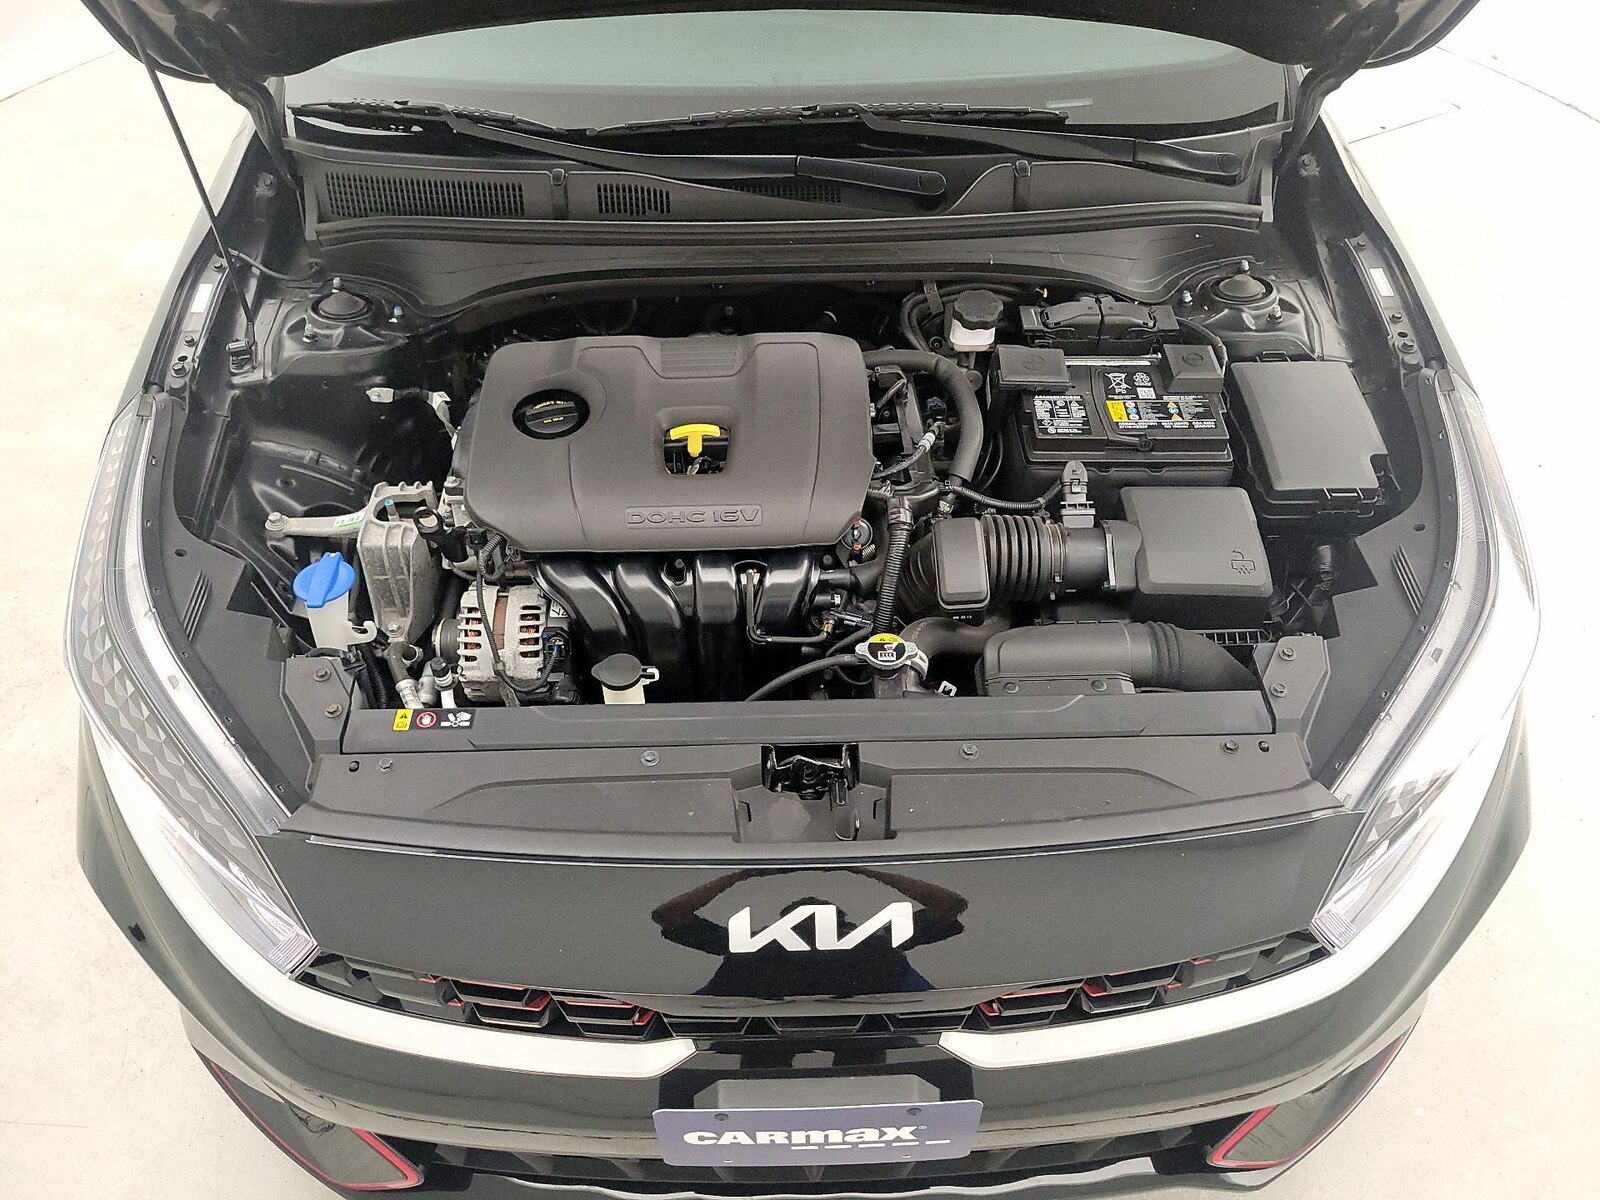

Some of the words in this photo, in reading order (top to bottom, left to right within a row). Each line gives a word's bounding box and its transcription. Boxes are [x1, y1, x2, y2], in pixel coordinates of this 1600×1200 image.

[626, 511, 706, 525] DOHC
[712, 508, 760, 523] 16V
[728, 901, 914, 953] KIA
